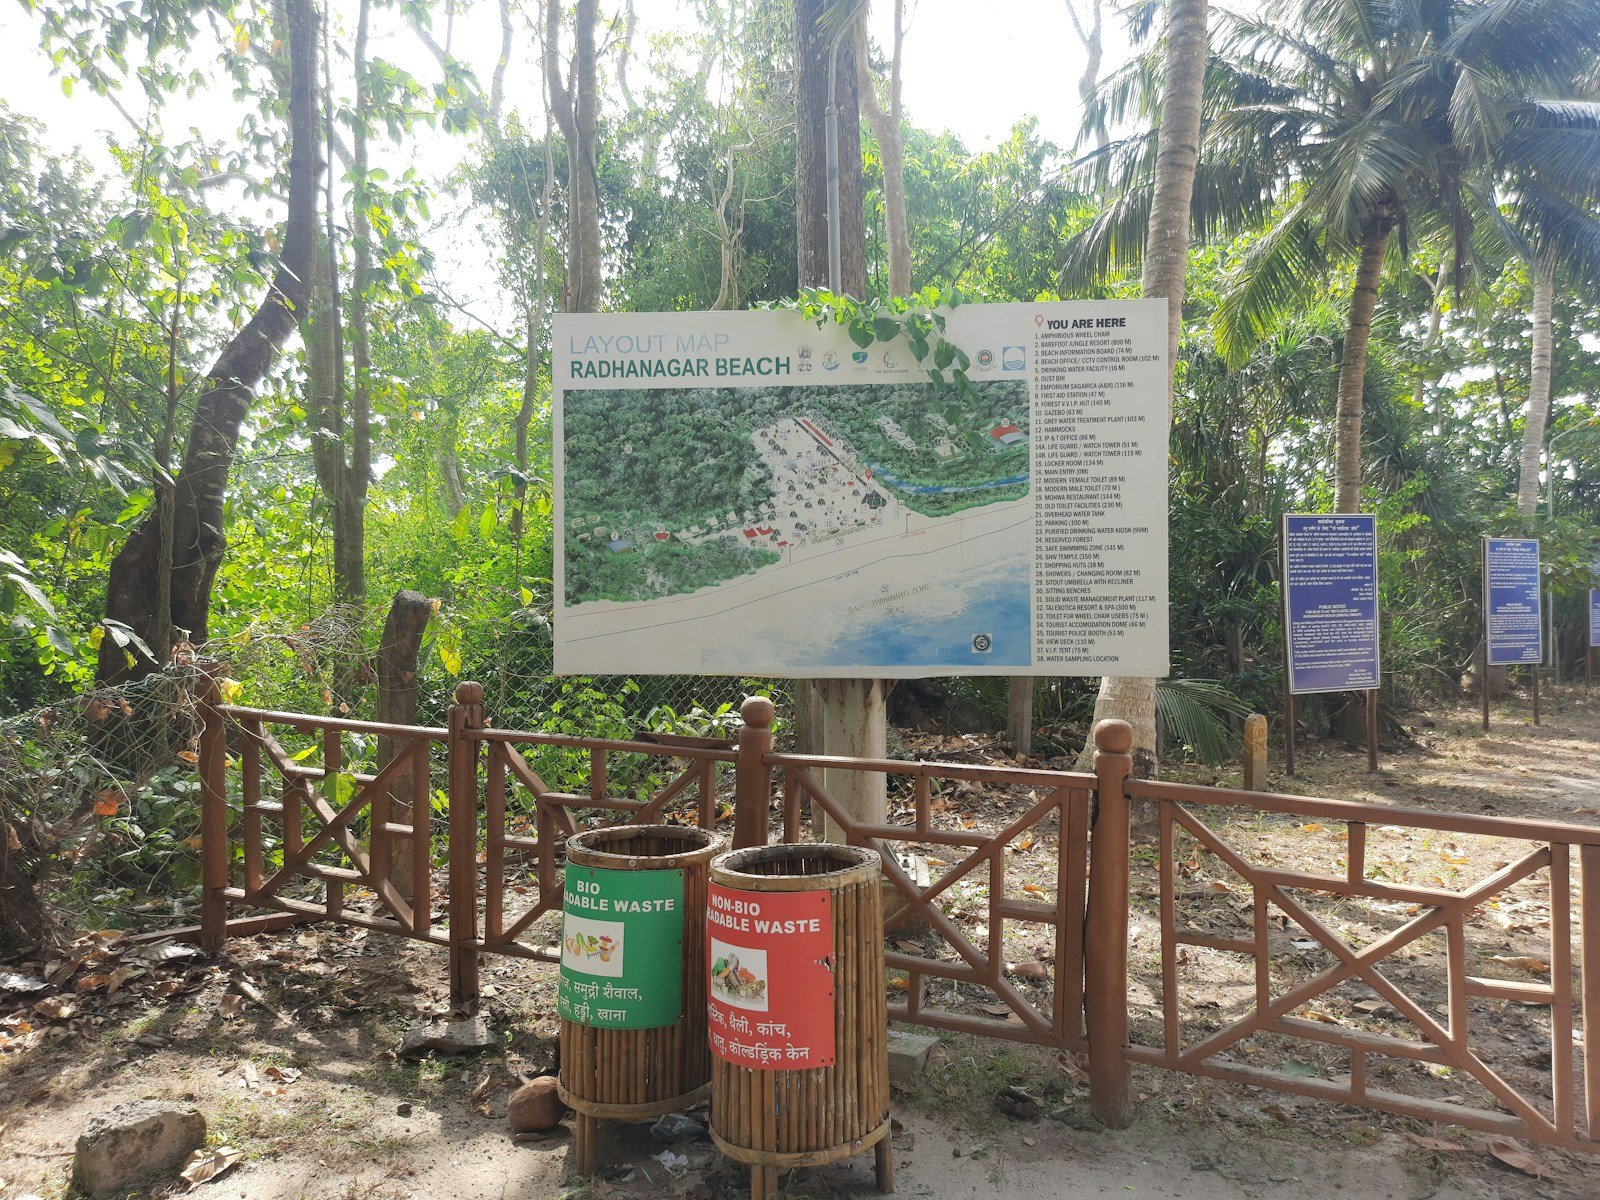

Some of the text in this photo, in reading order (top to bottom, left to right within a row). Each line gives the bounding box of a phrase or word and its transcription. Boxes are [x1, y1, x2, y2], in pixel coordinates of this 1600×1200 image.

[1048, 318, 1126, 330] YOU ARE HERE
[570, 333, 730, 354] LAYOUT MAP
[1139, 355, 1151, 363] (102
[570, 356, 790, 378] RADHANAGAR BEACH
[1098, 382, 1113, 390] (A&N)
[577, 880, 600, 895] BIO
[614, 899, 675, 912] WASTE
[712, 894, 760, 916] NON-BIO
[754, 919, 820, 934] WASTE
[573, 981, 600, 1000] समुद्री
[602, 982, 642, 1001] शैवाल,
[597, 1008, 627, 1021] खाना
[729, 1011, 753, 1037] थैली,
[757, 1020, 791, 1038] कांच,
[786, 1043, 810, 1060] केन
